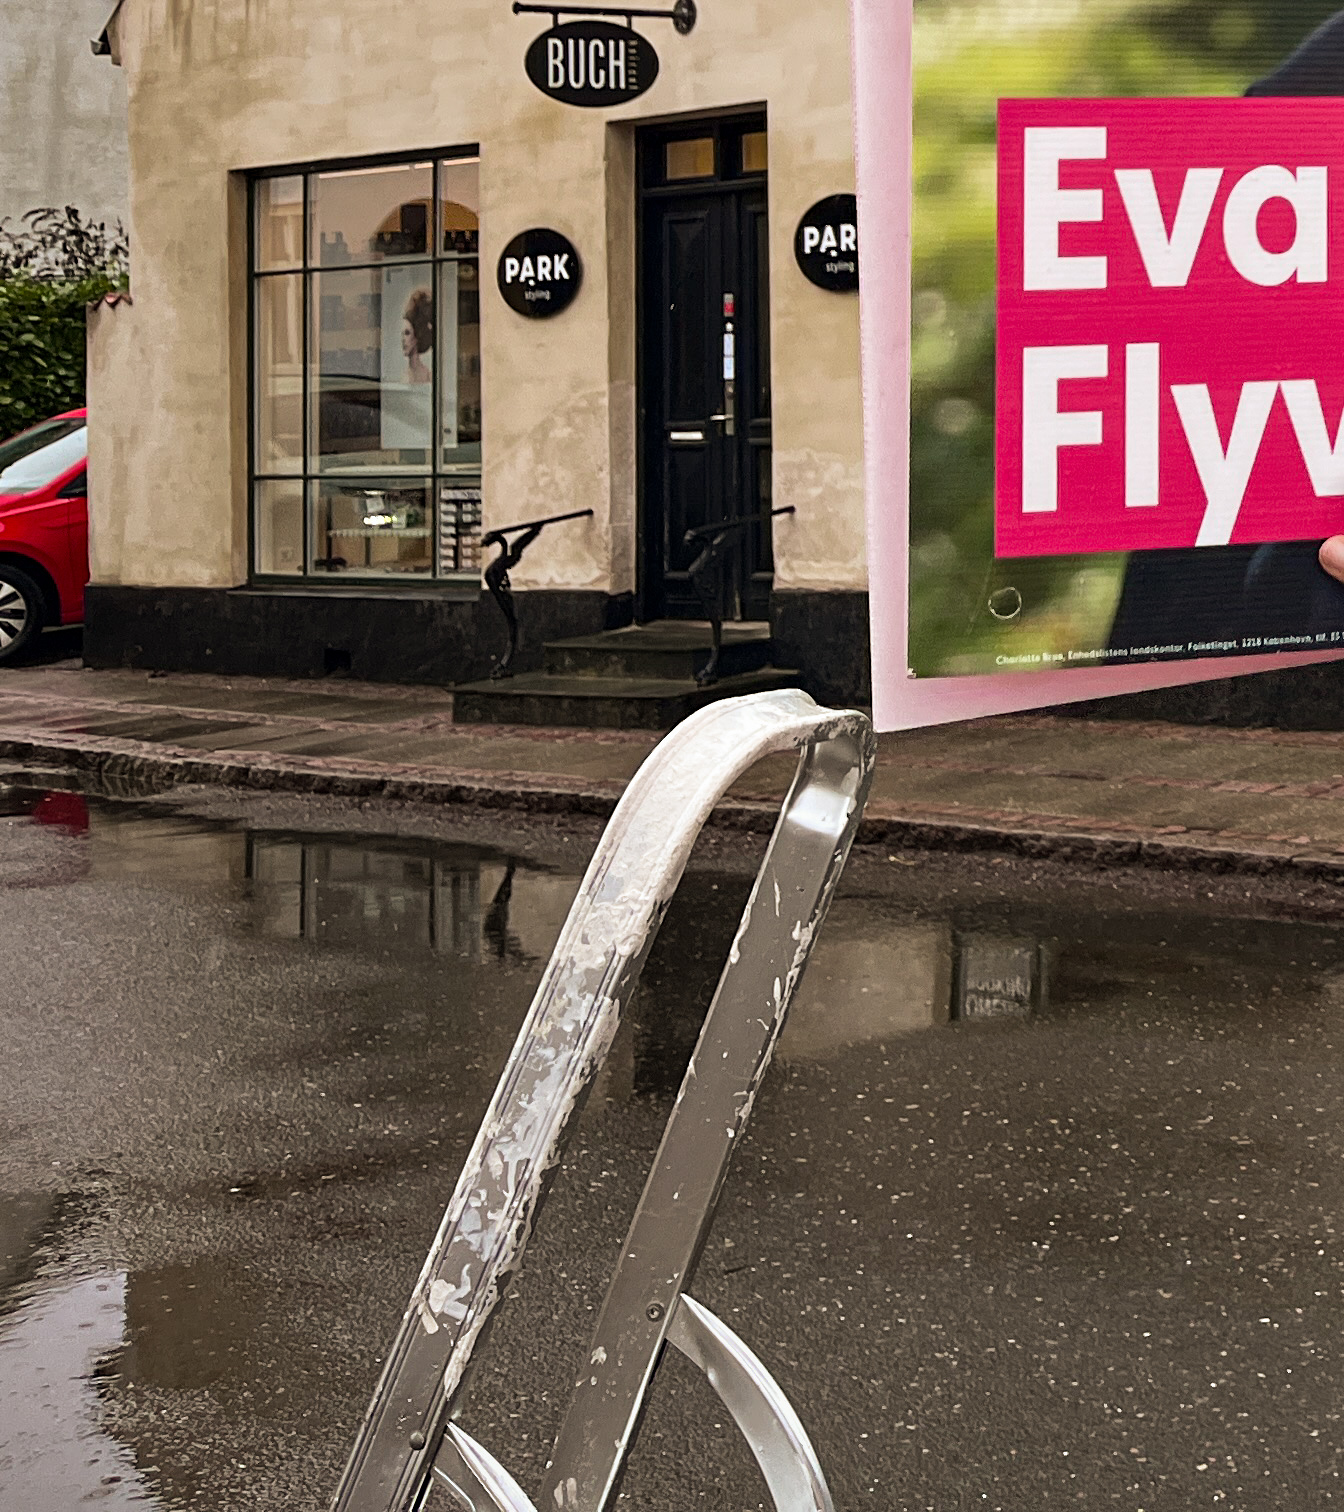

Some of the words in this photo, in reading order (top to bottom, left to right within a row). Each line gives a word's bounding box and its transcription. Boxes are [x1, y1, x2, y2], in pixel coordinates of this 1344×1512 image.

[547, 37, 626, 90] BUCH
[1023, 126, 1330, 291] Eva
[803, 223, 857, 257] PAR
[505, 253, 570, 286] PARK
